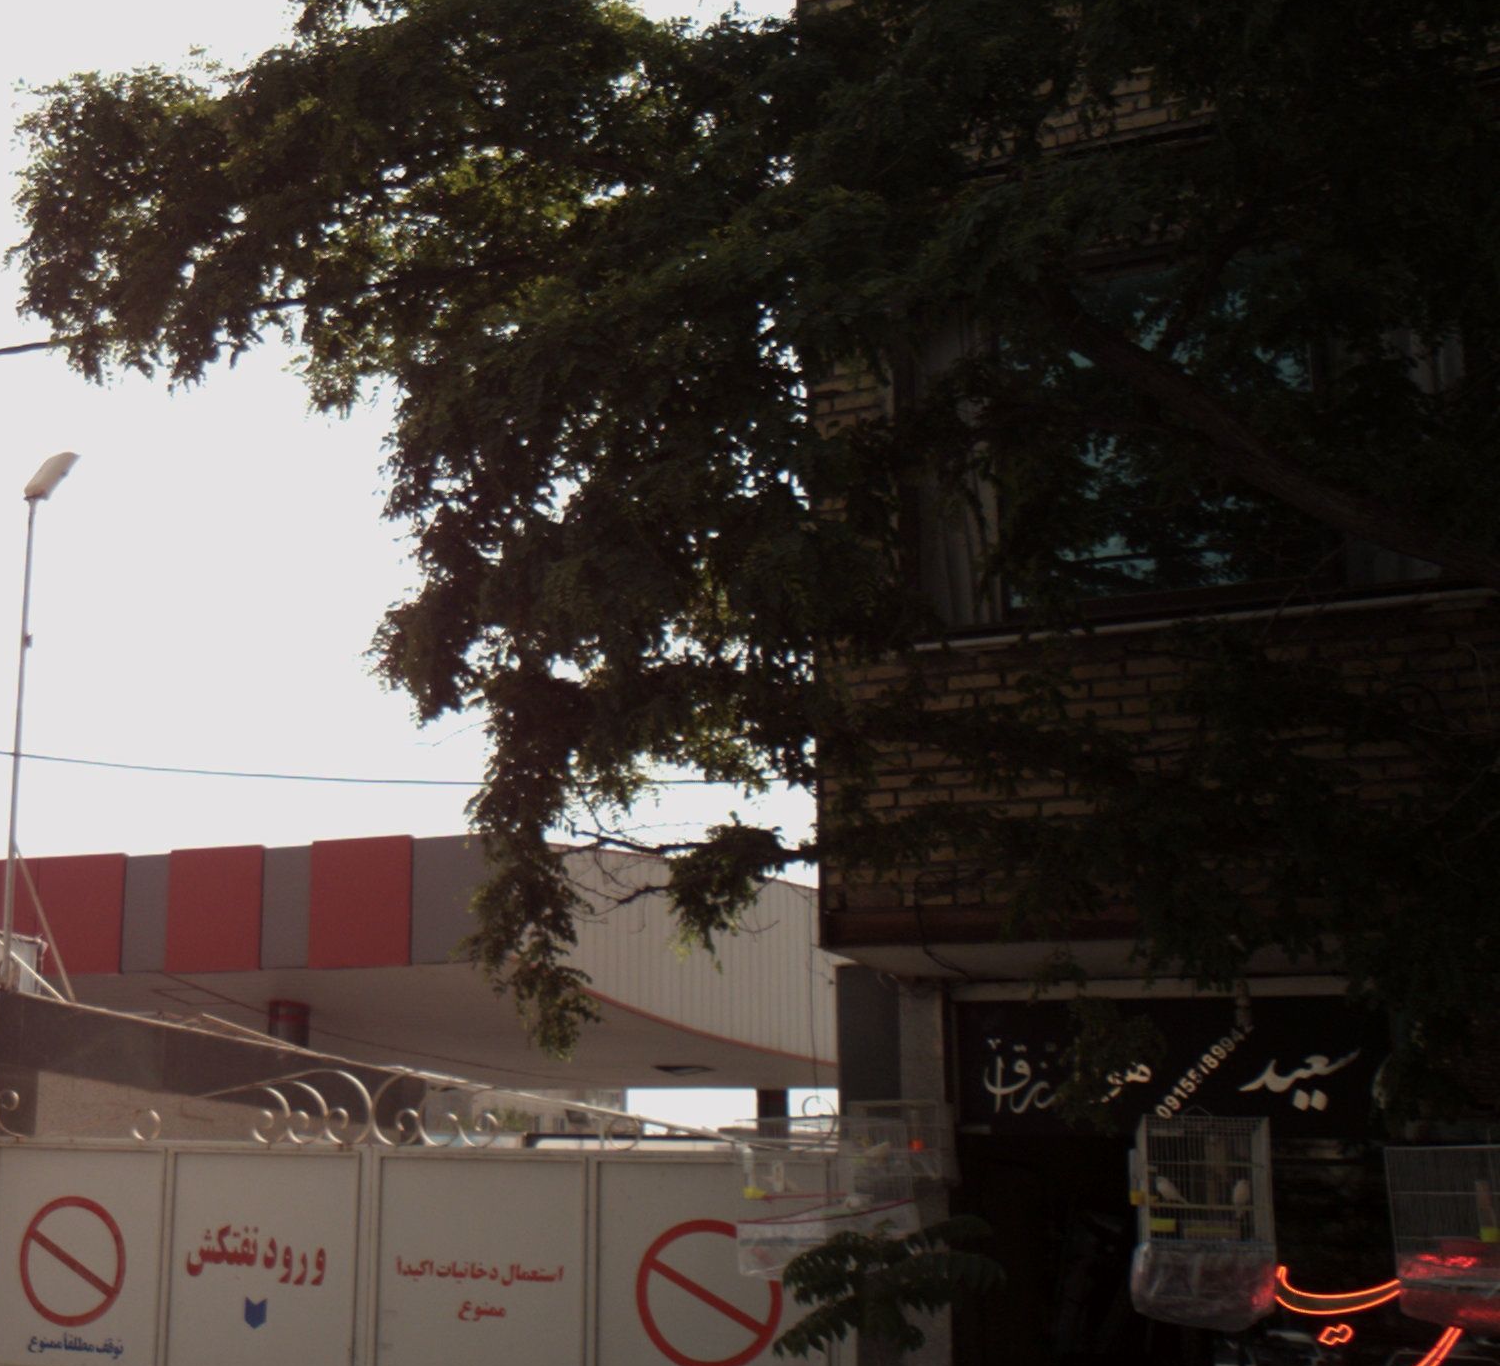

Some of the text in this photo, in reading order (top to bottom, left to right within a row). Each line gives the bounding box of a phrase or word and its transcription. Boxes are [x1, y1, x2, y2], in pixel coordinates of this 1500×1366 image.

[1237, 1047, 1362, 1112] سعید
[186, 1224, 327, 1286] ورود نفتکش
[436, 1260, 499, 1283] دخانیات
[501, 1262, 565, 1287] استعمال
[457, 1298, 507, 1322] ممنوع
[27, 1334, 63, 1354] ممنوع
[95, 1338, 125, 1360] توقف
